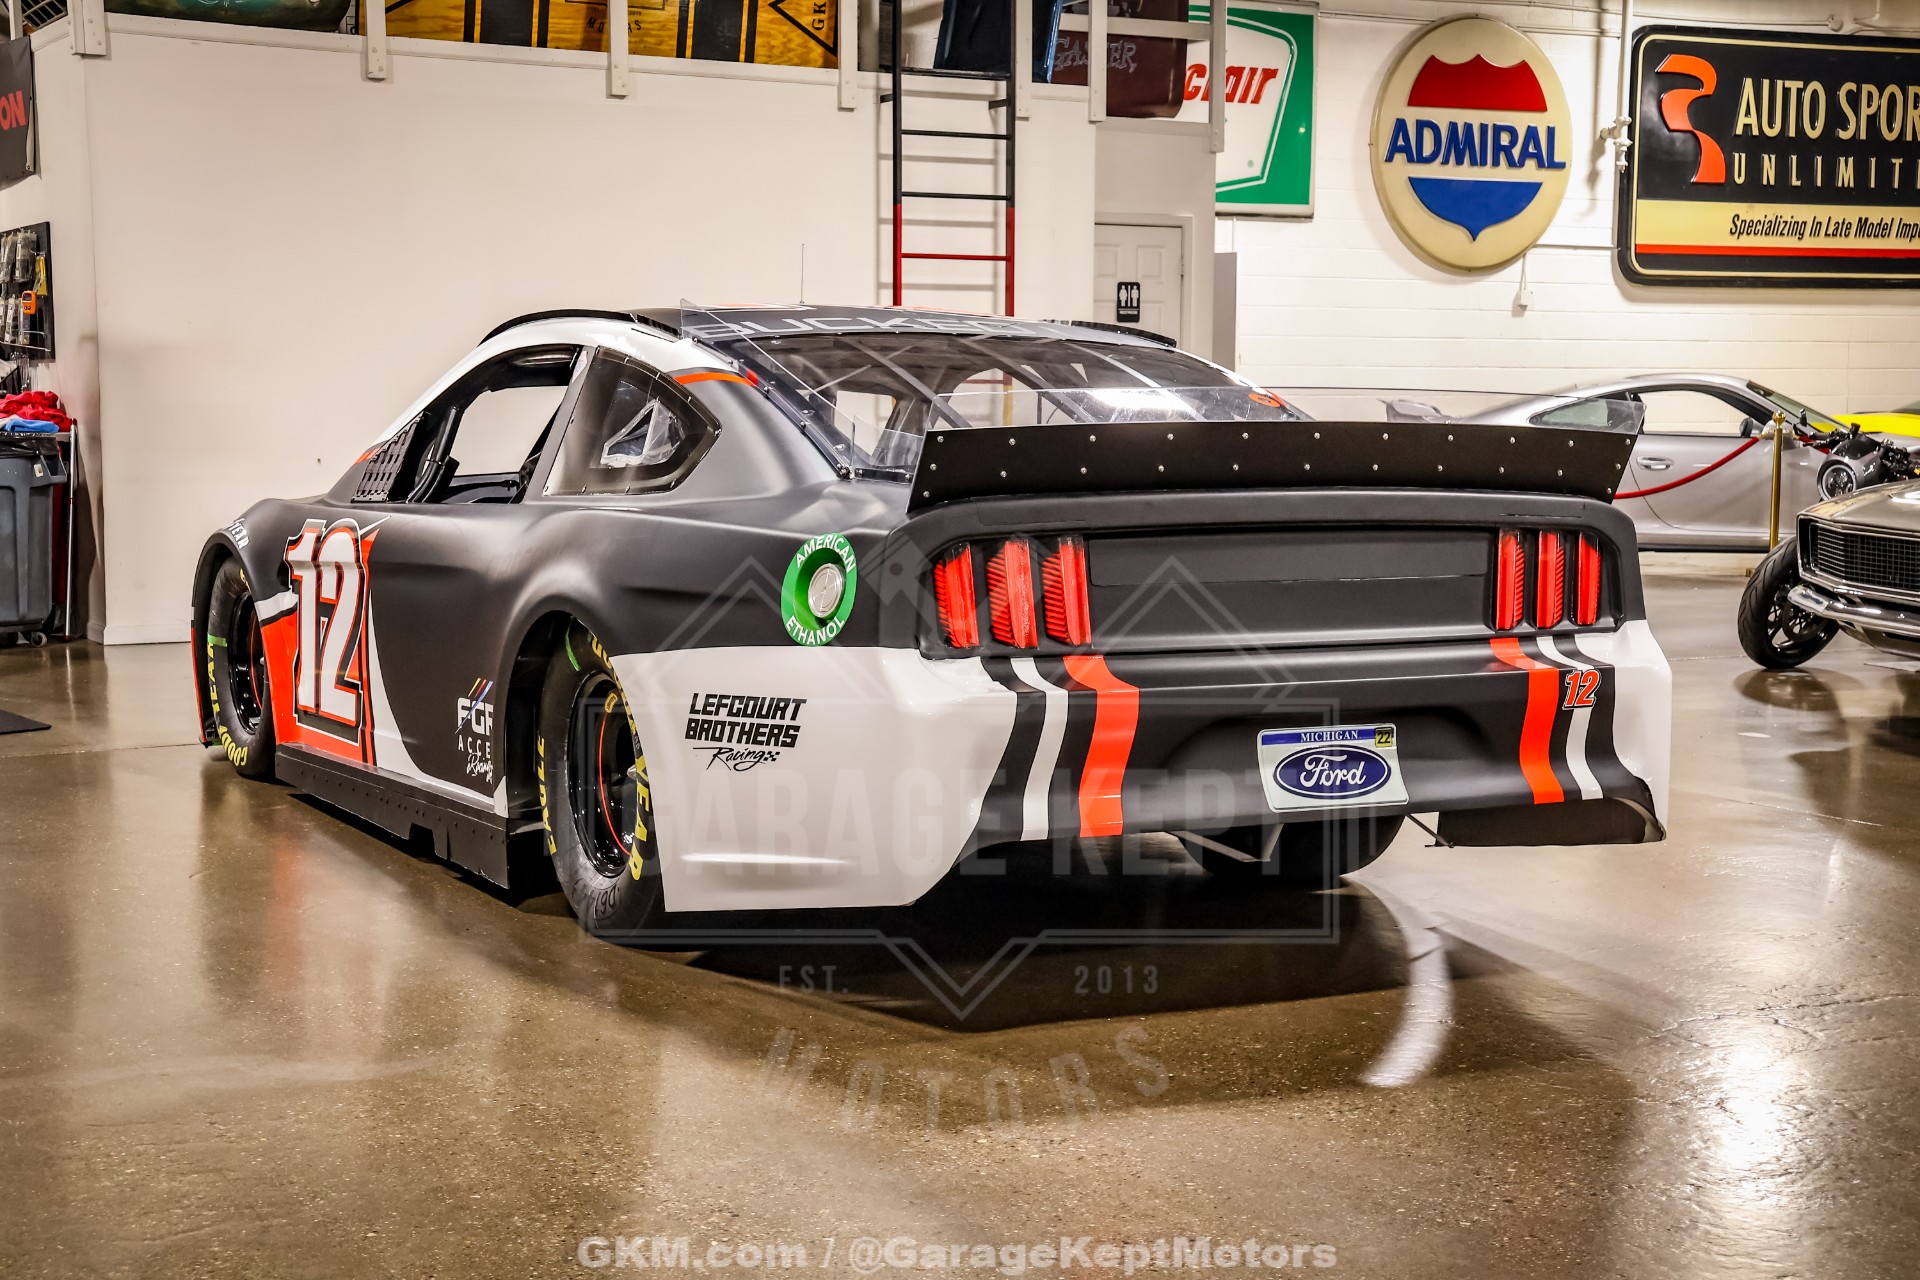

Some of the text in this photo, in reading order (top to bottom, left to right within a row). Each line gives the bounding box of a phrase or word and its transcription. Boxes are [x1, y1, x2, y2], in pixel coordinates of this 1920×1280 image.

[1732, 77, 1827, 140] AUTO
[1384, 117, 1567, 170] ADMIRAL
[1732, 152, 1920, 190] UNLIMIT
[1730, 213, 1808, 241] Specializing
[1808, 216, 1823, 238] In
[1824, 216, 1853, 239] Late
[1854, 216, 1894, 240] Model
[796, 534, 857, 574] AMERICAN
[284, 518, 365, 747] 12
[784, 615, 846, 646] ETHANOL
[1562, 669, 1602, 711] 12
[688, 692, 808, 722] LEFCOURT
[684, 717, 802, 749] BROTHERS
[1300, 730, 1359, 743] MICHIGAN
[1376, 731, 1391, 744] 22
[692, 746, 768, 772] Racing
[1299, 754, 1367, 788] Ford
